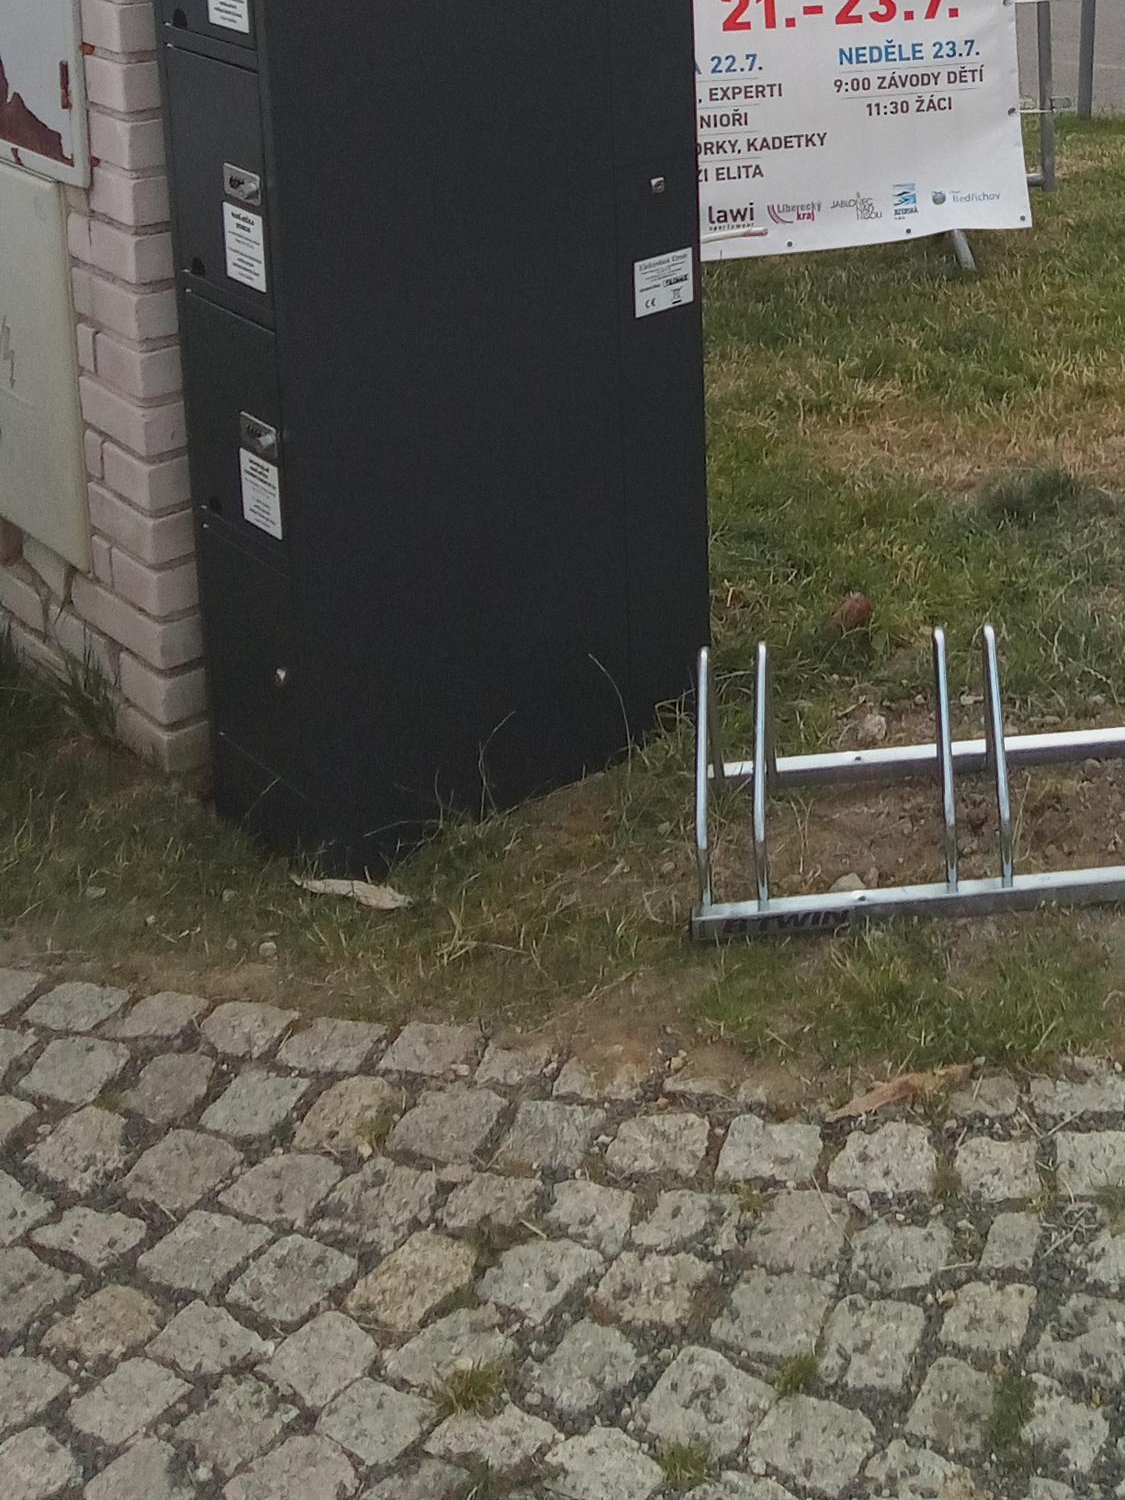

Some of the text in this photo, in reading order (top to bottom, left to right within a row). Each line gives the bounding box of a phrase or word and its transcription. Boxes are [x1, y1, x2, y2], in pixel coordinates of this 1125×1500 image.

[839, 39, 980, 65] NEDĚLE 23.7.
[710, 53, 763, 74] 22.7.
[834, 64, 984, 93] 9:00 ZÁVODY DĚTÍ
[709, 83, 783, 102] EXPERTI
[866, 94, 952, 117] 11:30 ŽÁCI
[700, 108, 748, 129] NIOŘI
[747, 132, 828, 152] KADETKY
[715, 164, 764, 181] ELITA
[708, 202, 754, 224] lawi
[777, 201, 822, 213] Liberecký
[796, 211, 815, 221] kraj
